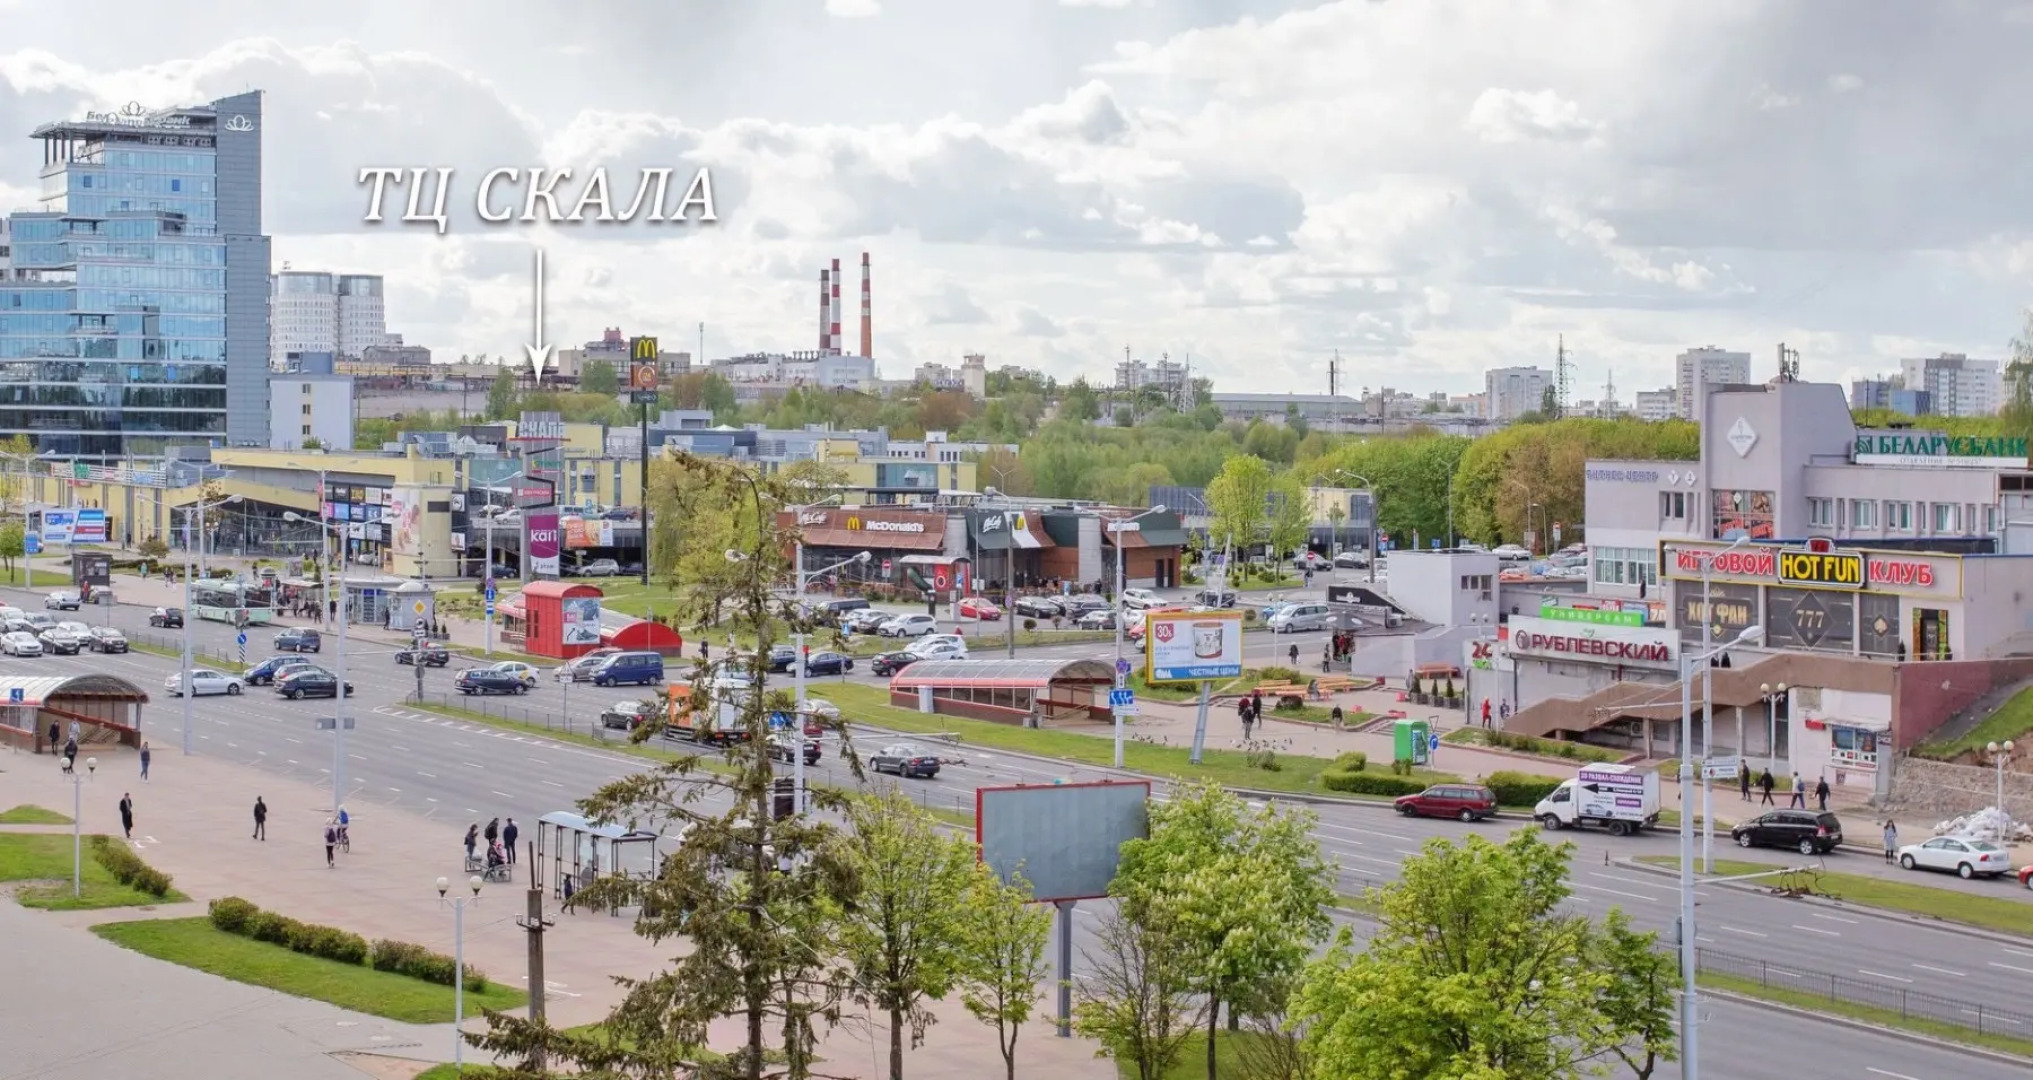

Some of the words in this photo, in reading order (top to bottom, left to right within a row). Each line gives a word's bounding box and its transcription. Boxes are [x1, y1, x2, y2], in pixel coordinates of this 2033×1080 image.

[1879, 435, 2029, 457] БЕЛАРУСБАНК
[530, 529, 557, 542] kari
[866, 520, 925, 532] McDonald's
[1676, 548, 1774, 576] ИГОВОЙ
[1780, 554, 1820, 580] HOT
[1823, 555, 1860, 583] FUN
[1868, 561, 1934, 587] КЛУБ
[1549, 608, 1632, 625] УНИВЕРСАМ
[1716, 603, 1747, 625] ФАН
[1796, 609, 1825, 629] 777
[1531, 634, 1669, 662] РУБЛЕВСКИЙ
[1188, 668, 1219, 677] ЧЕСТНЫЕ
[1220, 667, 1239, 676] ЦЕНЫ
